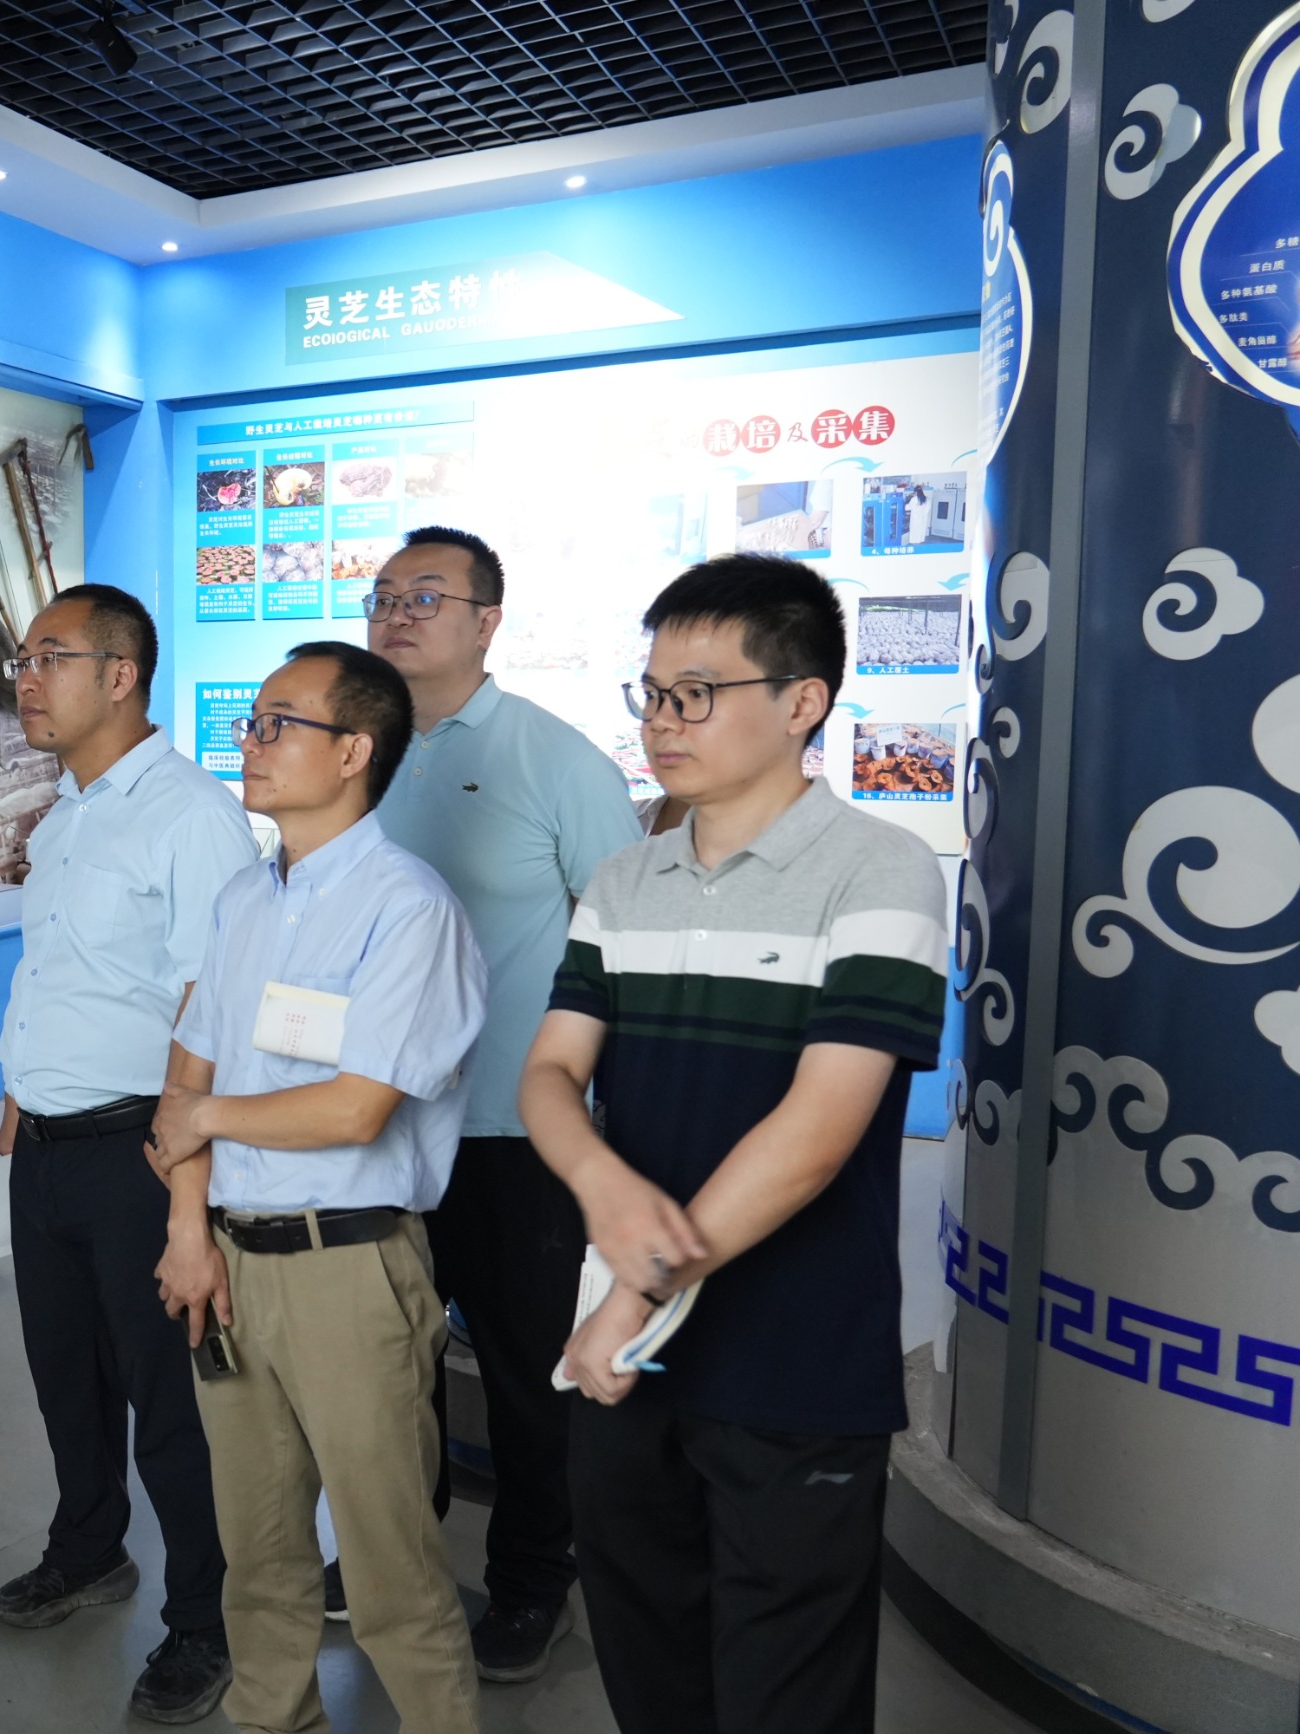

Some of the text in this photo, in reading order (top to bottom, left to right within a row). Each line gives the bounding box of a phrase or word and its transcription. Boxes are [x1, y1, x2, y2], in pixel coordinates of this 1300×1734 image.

[1249, 260, 1285, 273] 蛋白质
[1220, 284, 1277, 300] 多种氨基酸
[303, 269, 522, 330] 灵芝生态特性
[1219, 312, 1248, 323] 多肽类
[1259, 358, 1288, 369] 甘露醇
